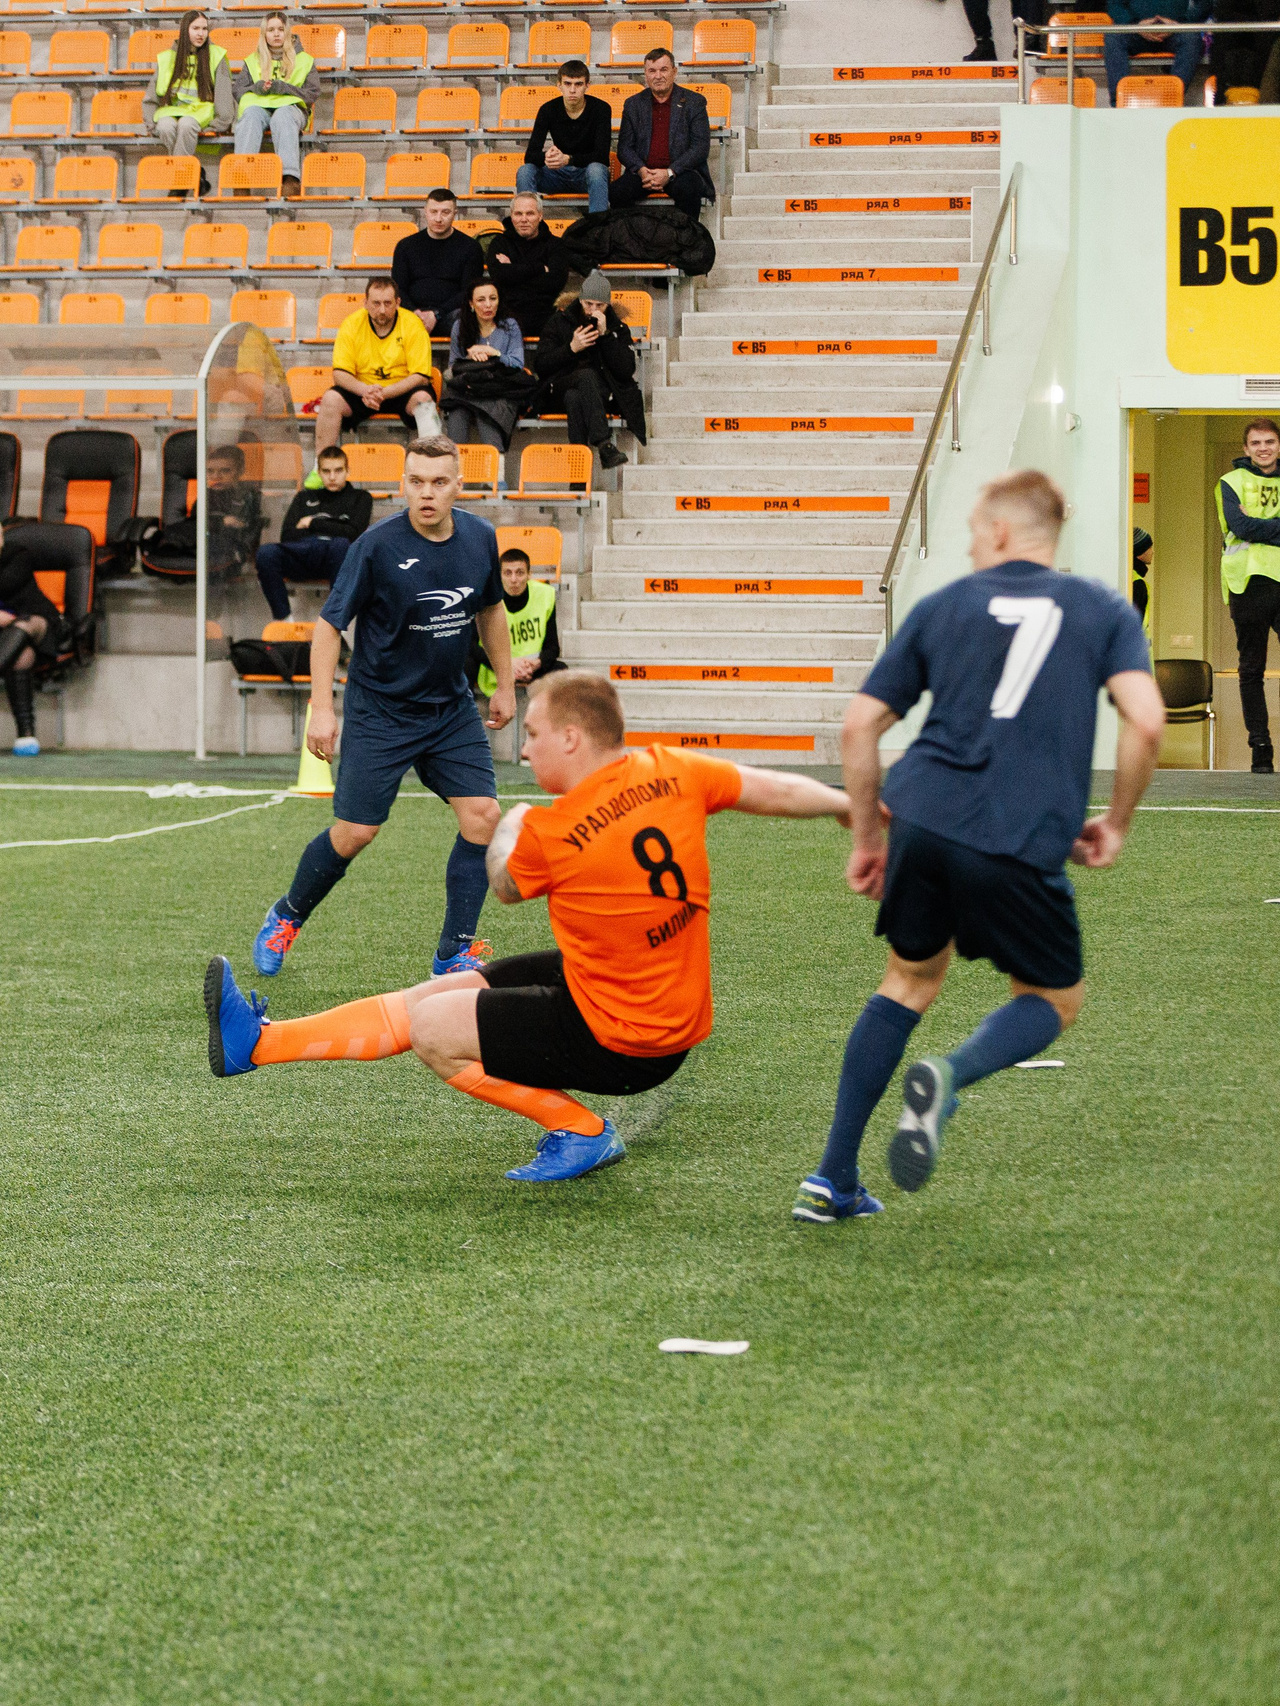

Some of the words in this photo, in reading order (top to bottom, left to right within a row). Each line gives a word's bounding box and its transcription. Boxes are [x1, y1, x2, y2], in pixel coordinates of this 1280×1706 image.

[912, 70, 933, 78] ряд
[938, 67, 950, 75] 10
[890, 135, 911, 143] ряд
[915, 133, 922, 141] 9
[867, 201, 888, 210] ряд
[893, 199, 899, 207] 8
[842, 272, 863, 280] ряд
[869, 269, 875, 277] 7
[818, 344, 840, 352] ряд
[845, 342, 851, 350] 6
[791, 422, 814, 430] ряд
[820, 419, 826, 428] 5
[765, 501, 787, 510] ряд
[793, 499, 800, 507] 4
[765, 581, 771, 590] 3
[429, 611, 466, 623] УРАЛЬСКИЙ
[433, 629, 462, 639] ХОЛДИНГ
[988, 596, 1063, 719] 7
[702, 670, 726, 679] ряд
[733, 667, 739, 677] 2
[681, 738, 707, 746] ряд
[632, 826, 688, 901] 8
